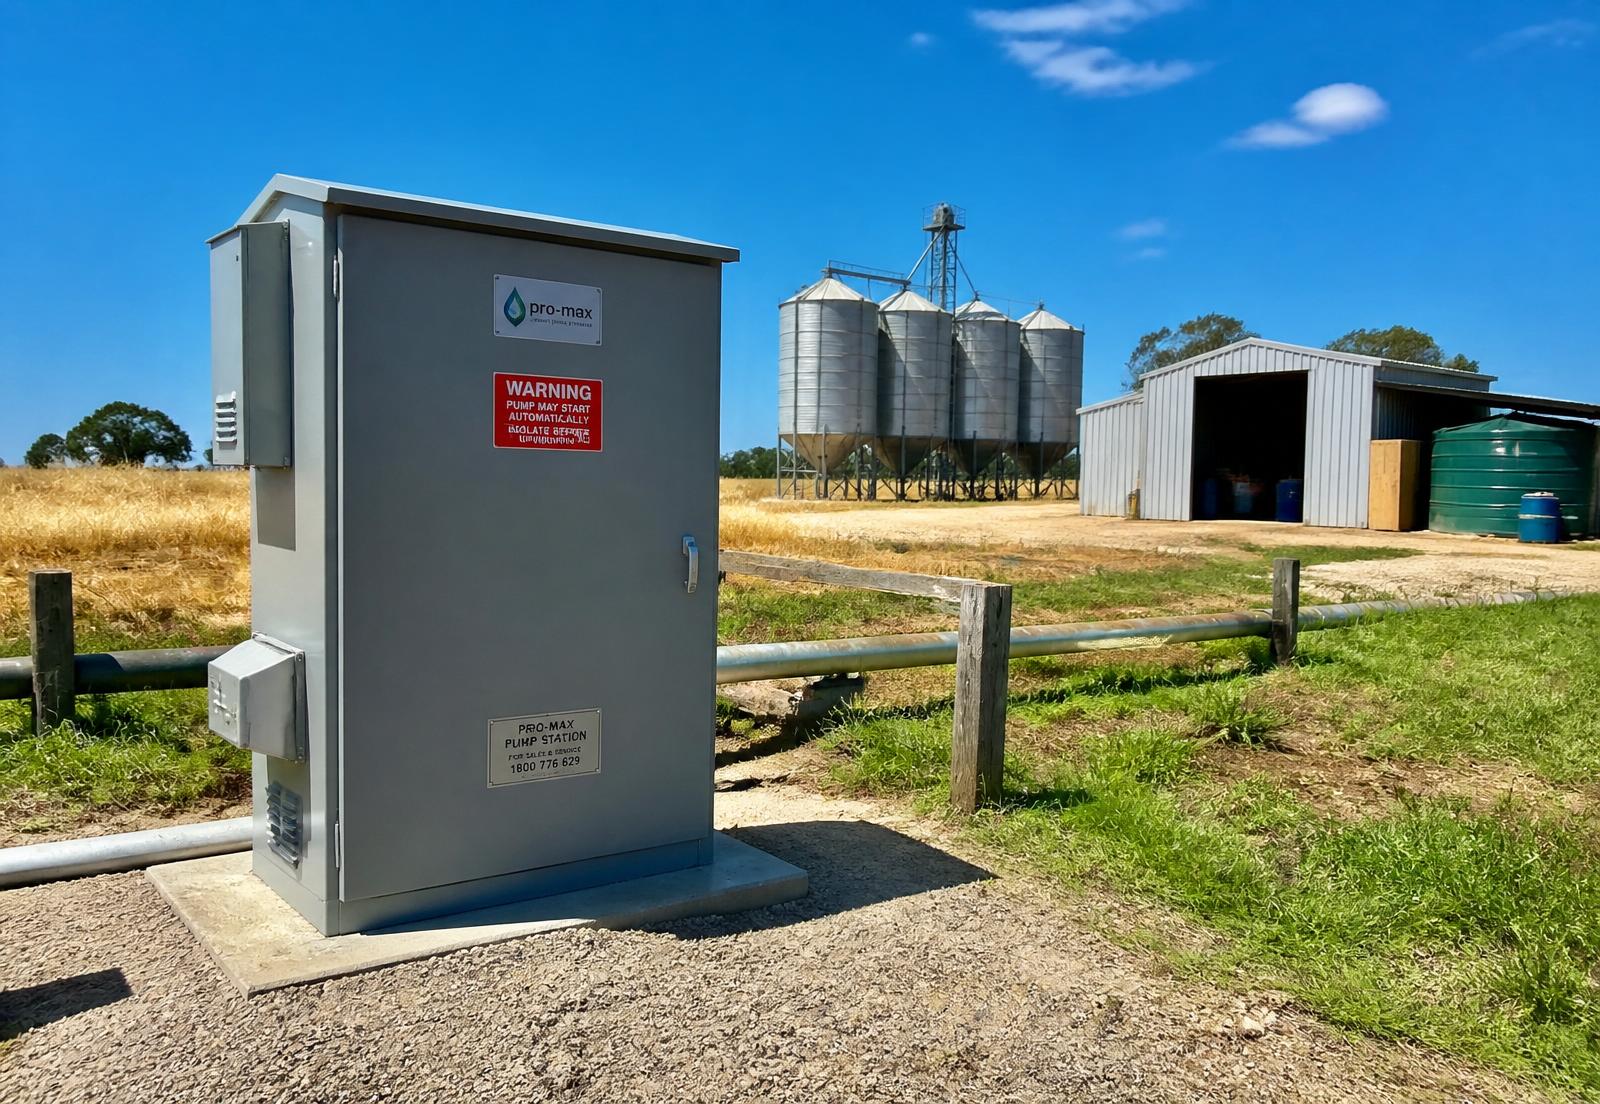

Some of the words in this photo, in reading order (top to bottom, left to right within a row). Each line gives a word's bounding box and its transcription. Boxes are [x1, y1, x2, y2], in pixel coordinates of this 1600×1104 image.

[530, 302, 593, 320] pro-max
[506, 380, 592, 401] WARNING
[506, 400, 535, 410] PUMP
[537, 402, 559, 412] MAY
[561, 403, 591, 414] START
[508, 412, 590, 425] AUTOMATICALLY
[518, 720, 575, 734] PRO-MAX
[505, 736, 537, 749] PUMP
[541, 730, 587, 745] STATION
[511, 762, 536, 774] 1800
[540, 759, 558, 770] 776
[562, 756, 580, 767] 629
